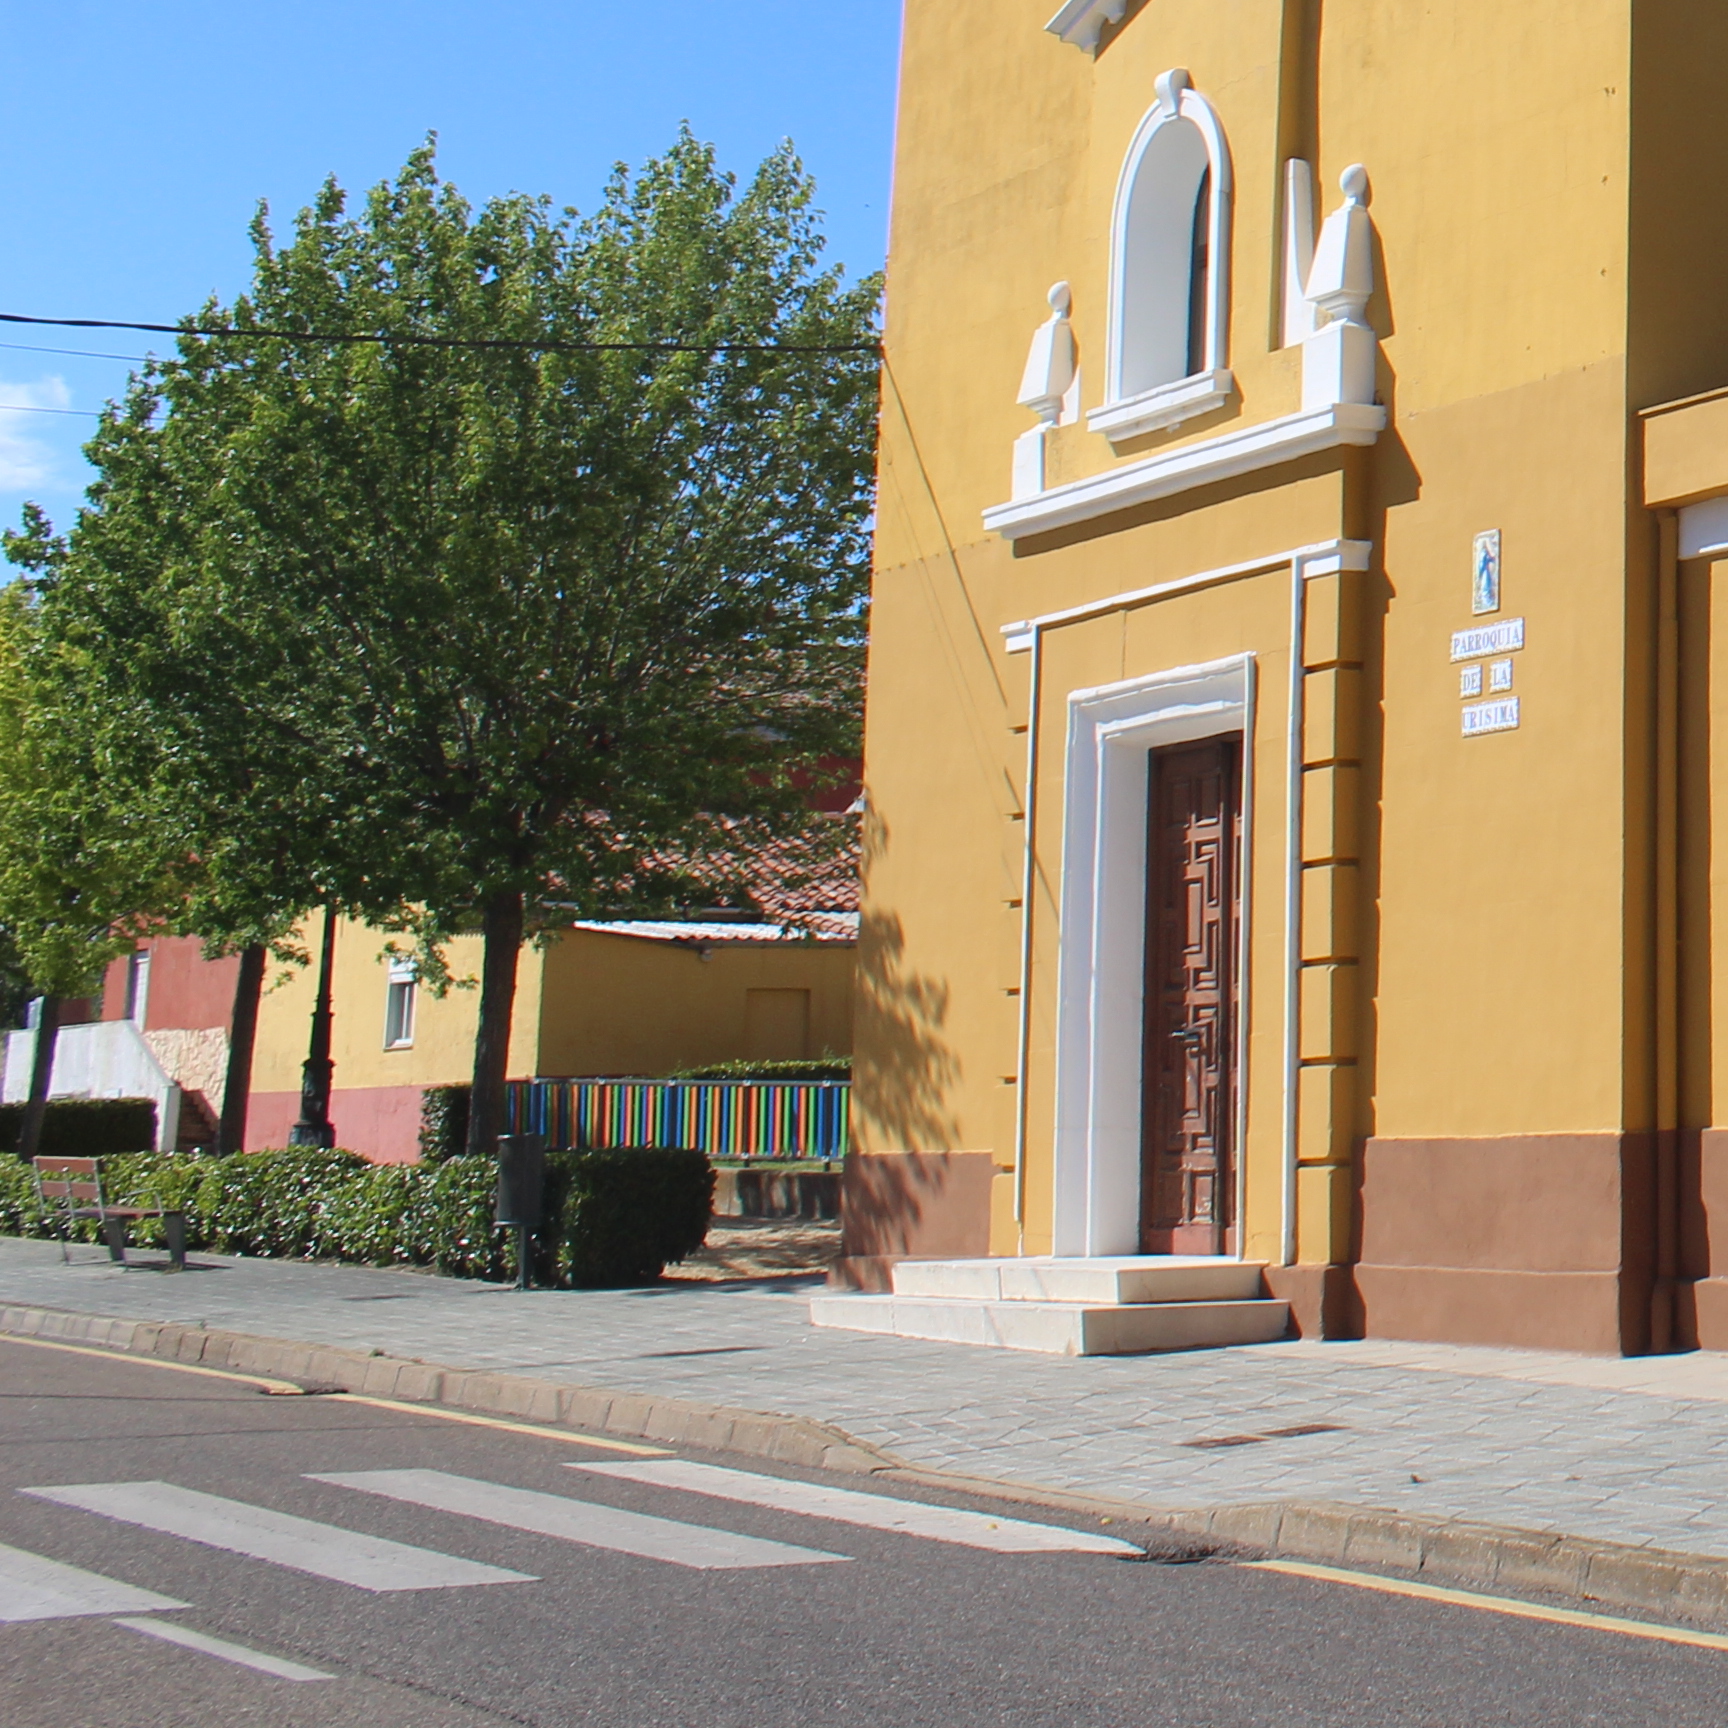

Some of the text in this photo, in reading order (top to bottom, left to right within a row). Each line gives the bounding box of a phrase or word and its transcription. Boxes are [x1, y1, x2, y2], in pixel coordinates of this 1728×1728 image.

[1453, 626, 1521, 655] PARROQUIA
[1462, 667, 1508, 692] DE LA
